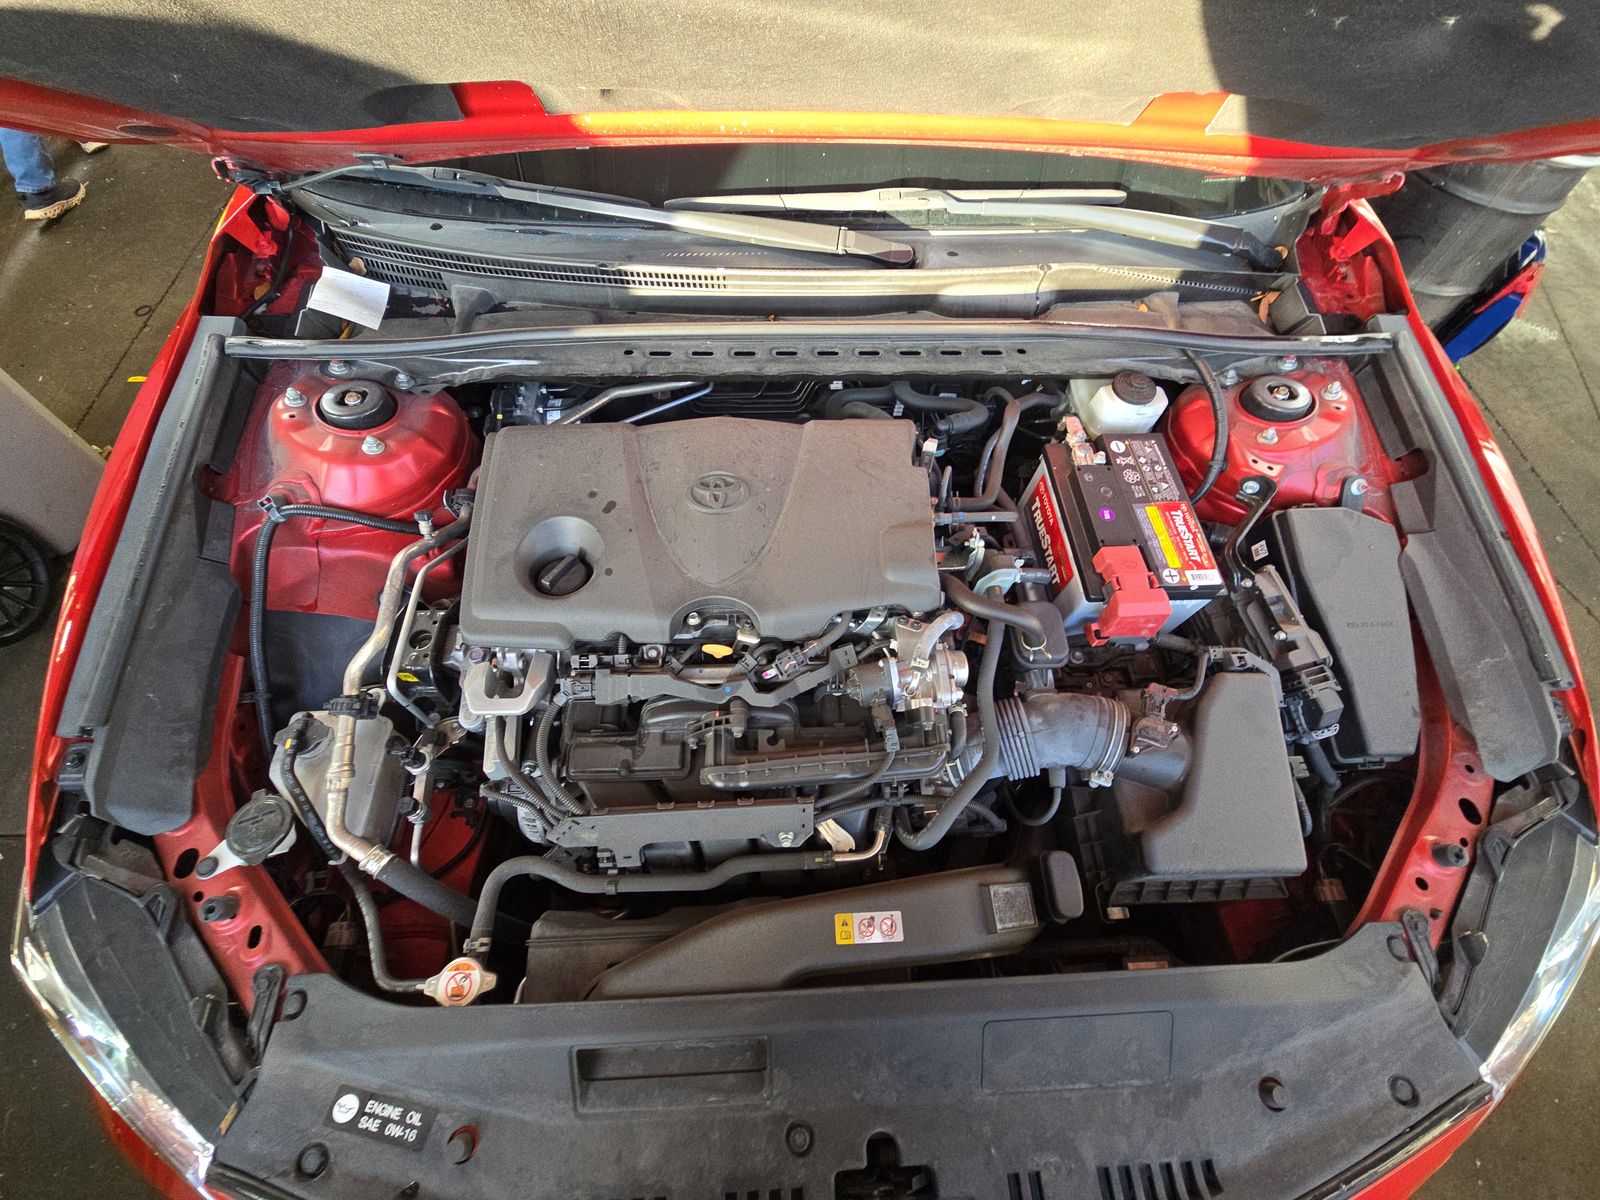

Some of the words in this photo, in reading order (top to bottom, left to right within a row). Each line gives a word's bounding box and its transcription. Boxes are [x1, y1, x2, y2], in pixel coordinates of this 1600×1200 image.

[1041, 492, 1054, 527] TOYOTA
[1184, 512, 1198, 533] TOYOTA
[364, 1100, 404, 1121] ENGINE
[405, 1111, 423, 1127] OIL
[357, 1116, 382, 1133] SAE
[384, 1122, 418, 1143] 0W-16
